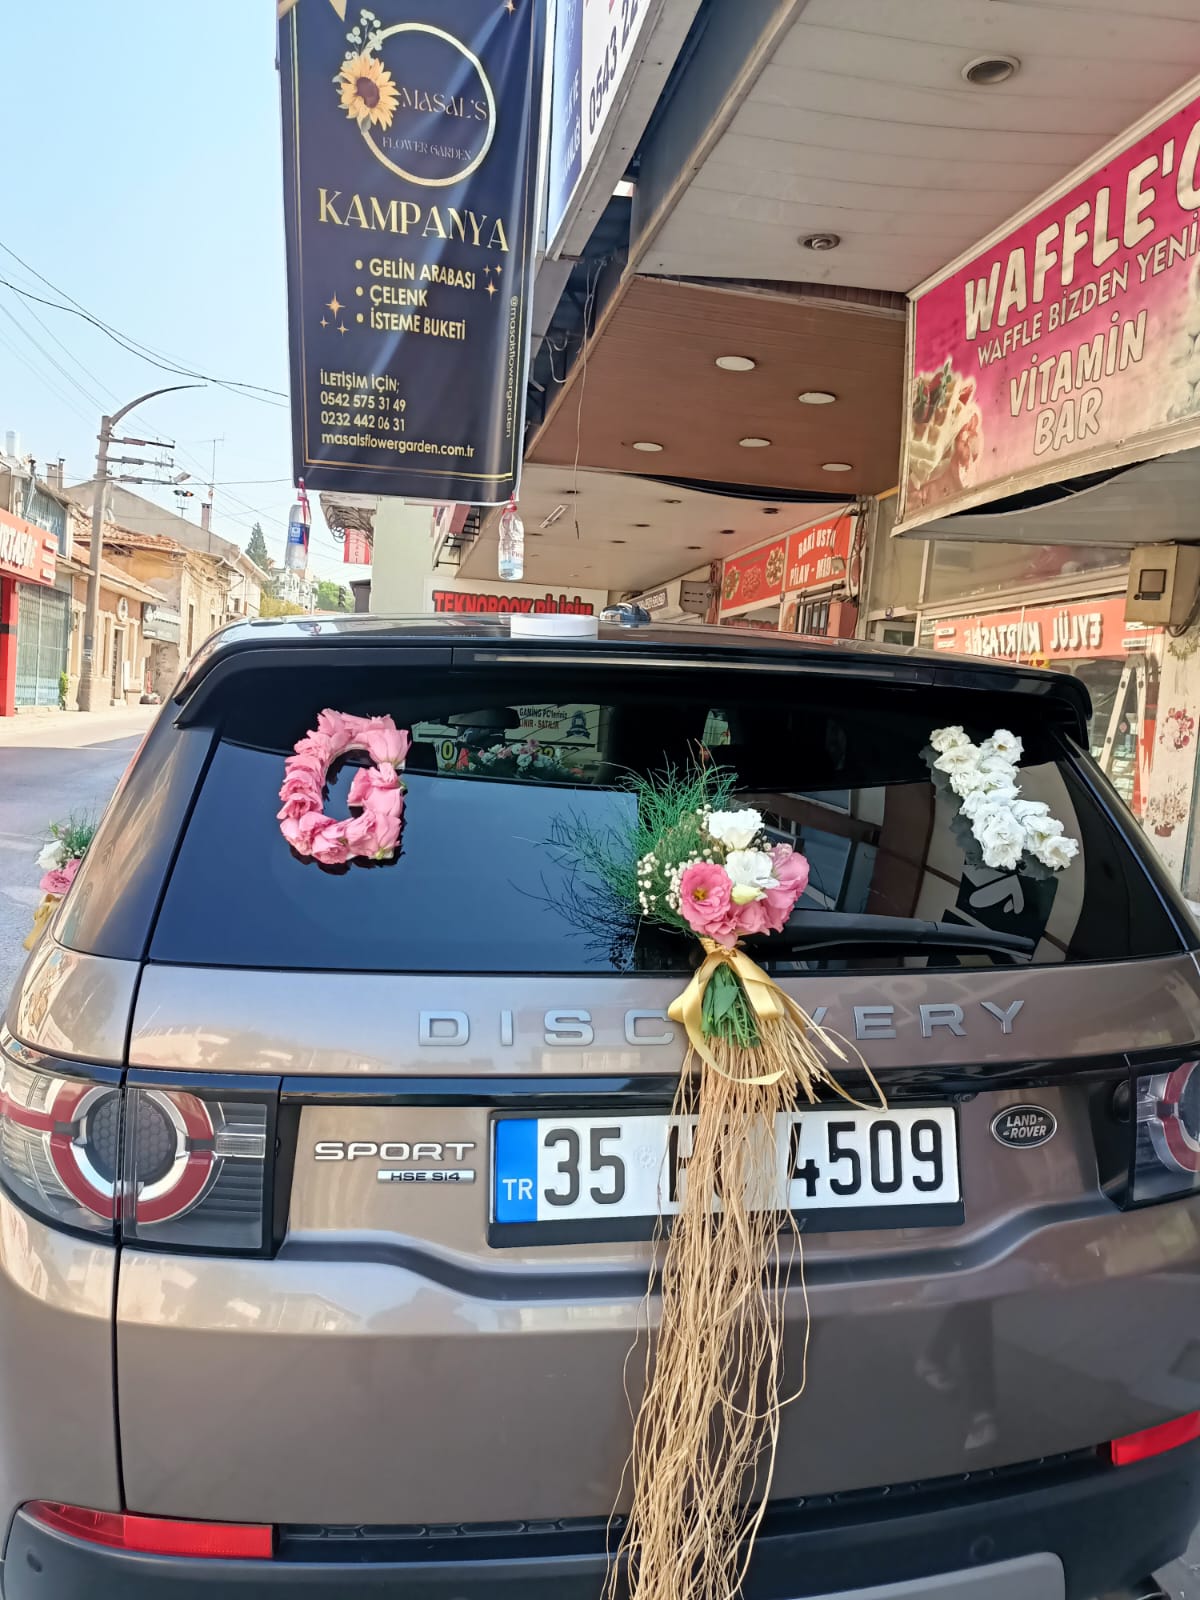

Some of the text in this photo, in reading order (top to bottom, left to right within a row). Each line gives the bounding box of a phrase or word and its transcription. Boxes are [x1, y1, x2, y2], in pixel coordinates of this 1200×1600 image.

[589, 26, 617, 135] 0543
[402, 87, 487, 121] MASAL'S
[382, 136, 472, 161] FLOWER GARDEN
[318, 187, 509, 252] KAMPANYA
[369, 257, 476, 291] GELİN ARABASI
[369, 284, 428, 307] ÇELENK
[370, 307, 466, 341] İSTEME BUKETİ
[976, 310, 1042, 369] WAFFLE
[1048, 260, 1129, 334] BİZDEN
[320, 368, 368, 390] İLETİŞİM
[1008, 310, 1148, 417] VİTAMİN
[320, 391, 406, 412] 0542 575 31 49
[320, 411, 405, 432] 0232 442 06 31
[1033, 388, 1103, 456] BAR
[321, 433, 475, 458] masalsflowergarden.com.tr
[789, 563, 810, 587] PİLAV
[418, 1000, 1025, 1047] DISCERY
[314, 1141, 476, 1161] SPORT
[502, 1178, 533, 1201] TR
[544, 1127, 625, 1206] 35
[787, 1119, 944, 1197] 4509
[390, 1171, 426, 1182] HSE
